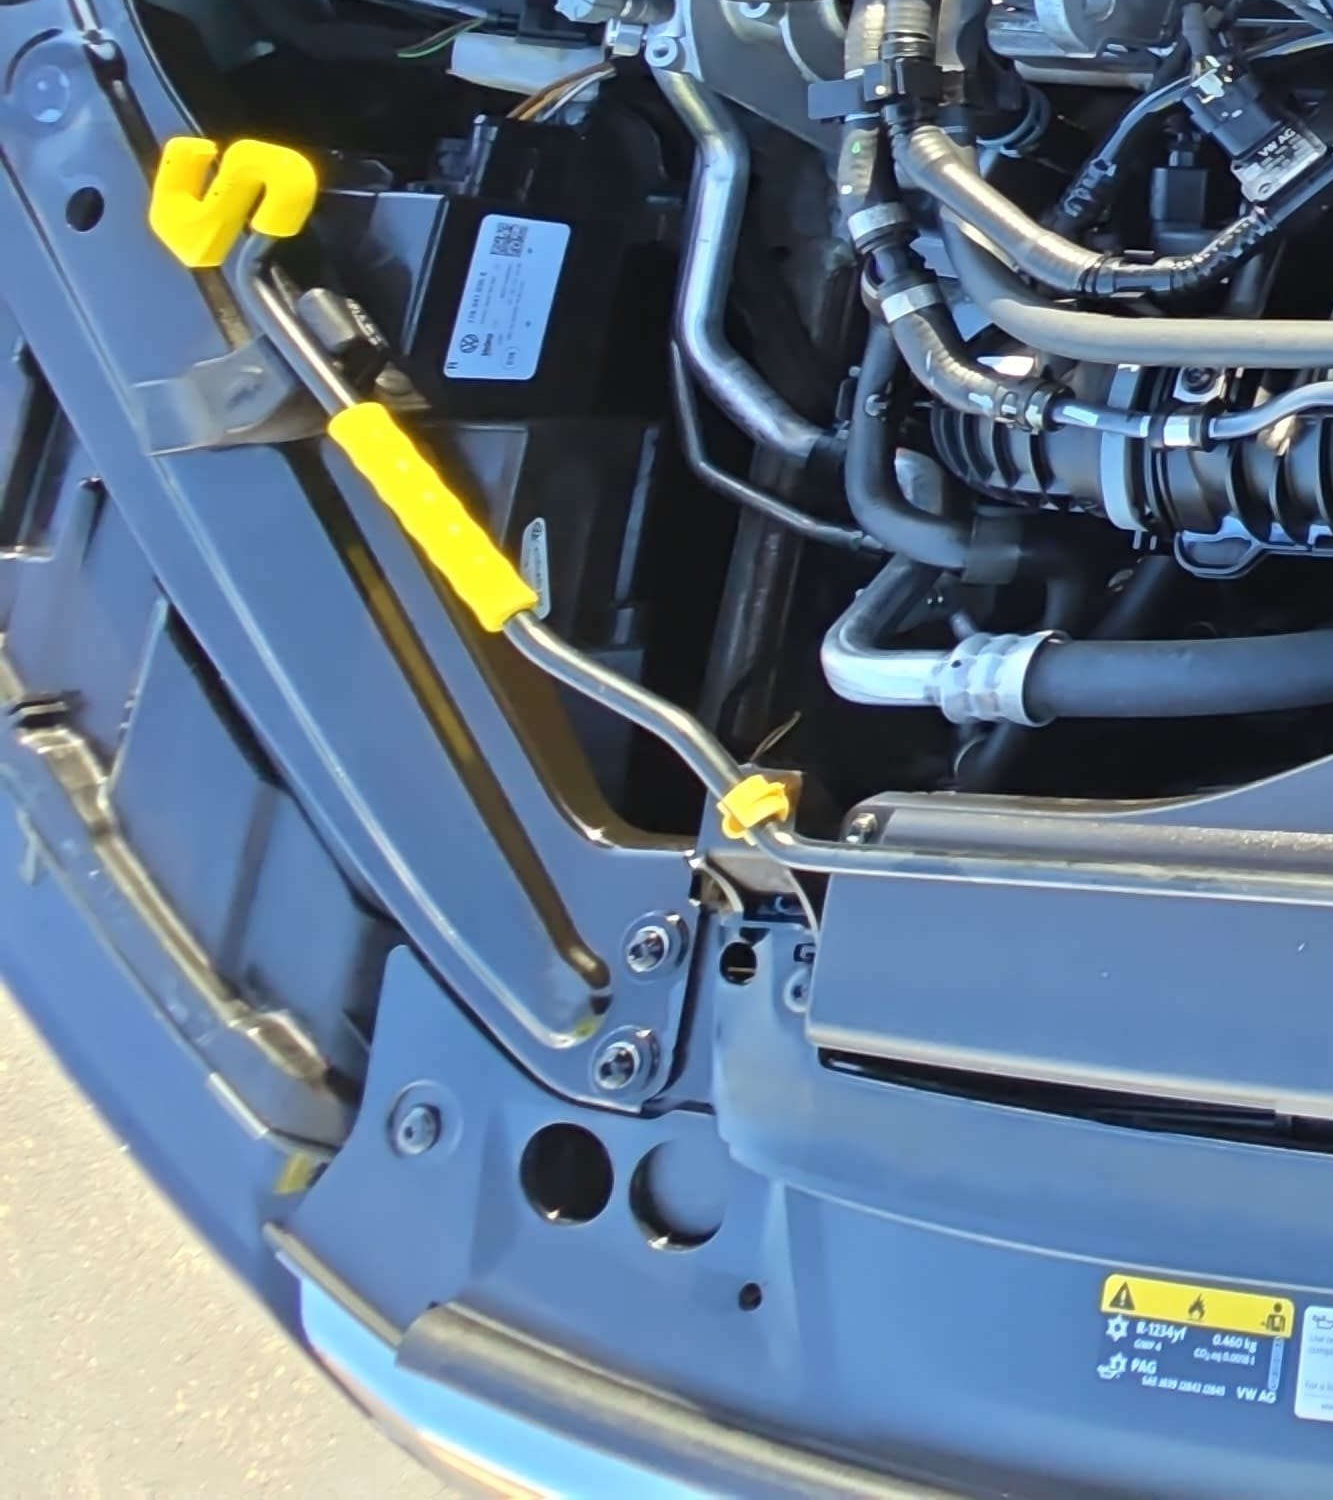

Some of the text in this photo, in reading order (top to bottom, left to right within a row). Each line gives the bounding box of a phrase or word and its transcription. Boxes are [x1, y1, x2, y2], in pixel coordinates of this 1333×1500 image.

[1257, 126, 1297, 160] VW AG
[1243, 1338, 1258, 1353] kg
[1130, 1357, 1157, 1374] PAG
[1234, 1385, 1258, 1400] VW
[1257, 1389, 1277, 1403] AG
